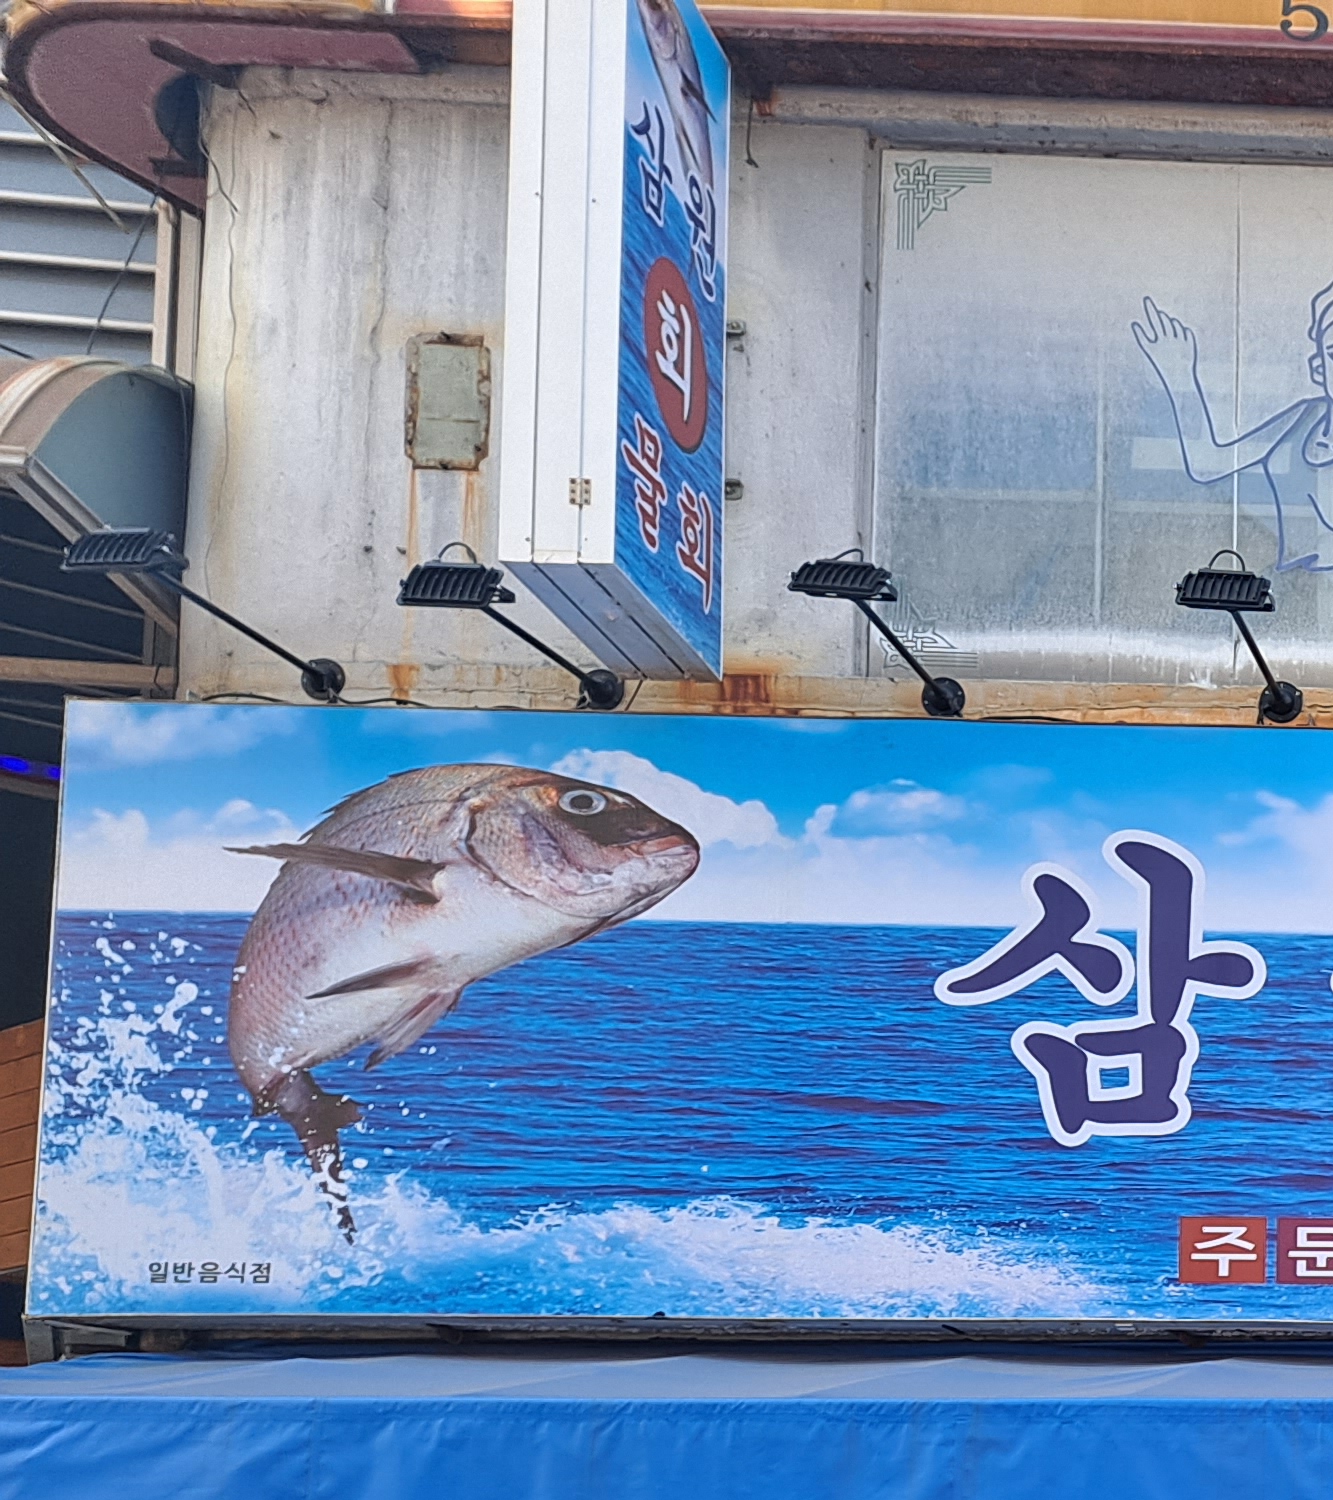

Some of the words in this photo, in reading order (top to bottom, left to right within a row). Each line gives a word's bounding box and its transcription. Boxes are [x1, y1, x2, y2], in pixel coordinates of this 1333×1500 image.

[632, 98, 717, 303] 삼원
[655, 288, 693, 424] 회
[620, 411, 712, 615] 물회
[148, 1261, 272, 1284] 일반음식점
